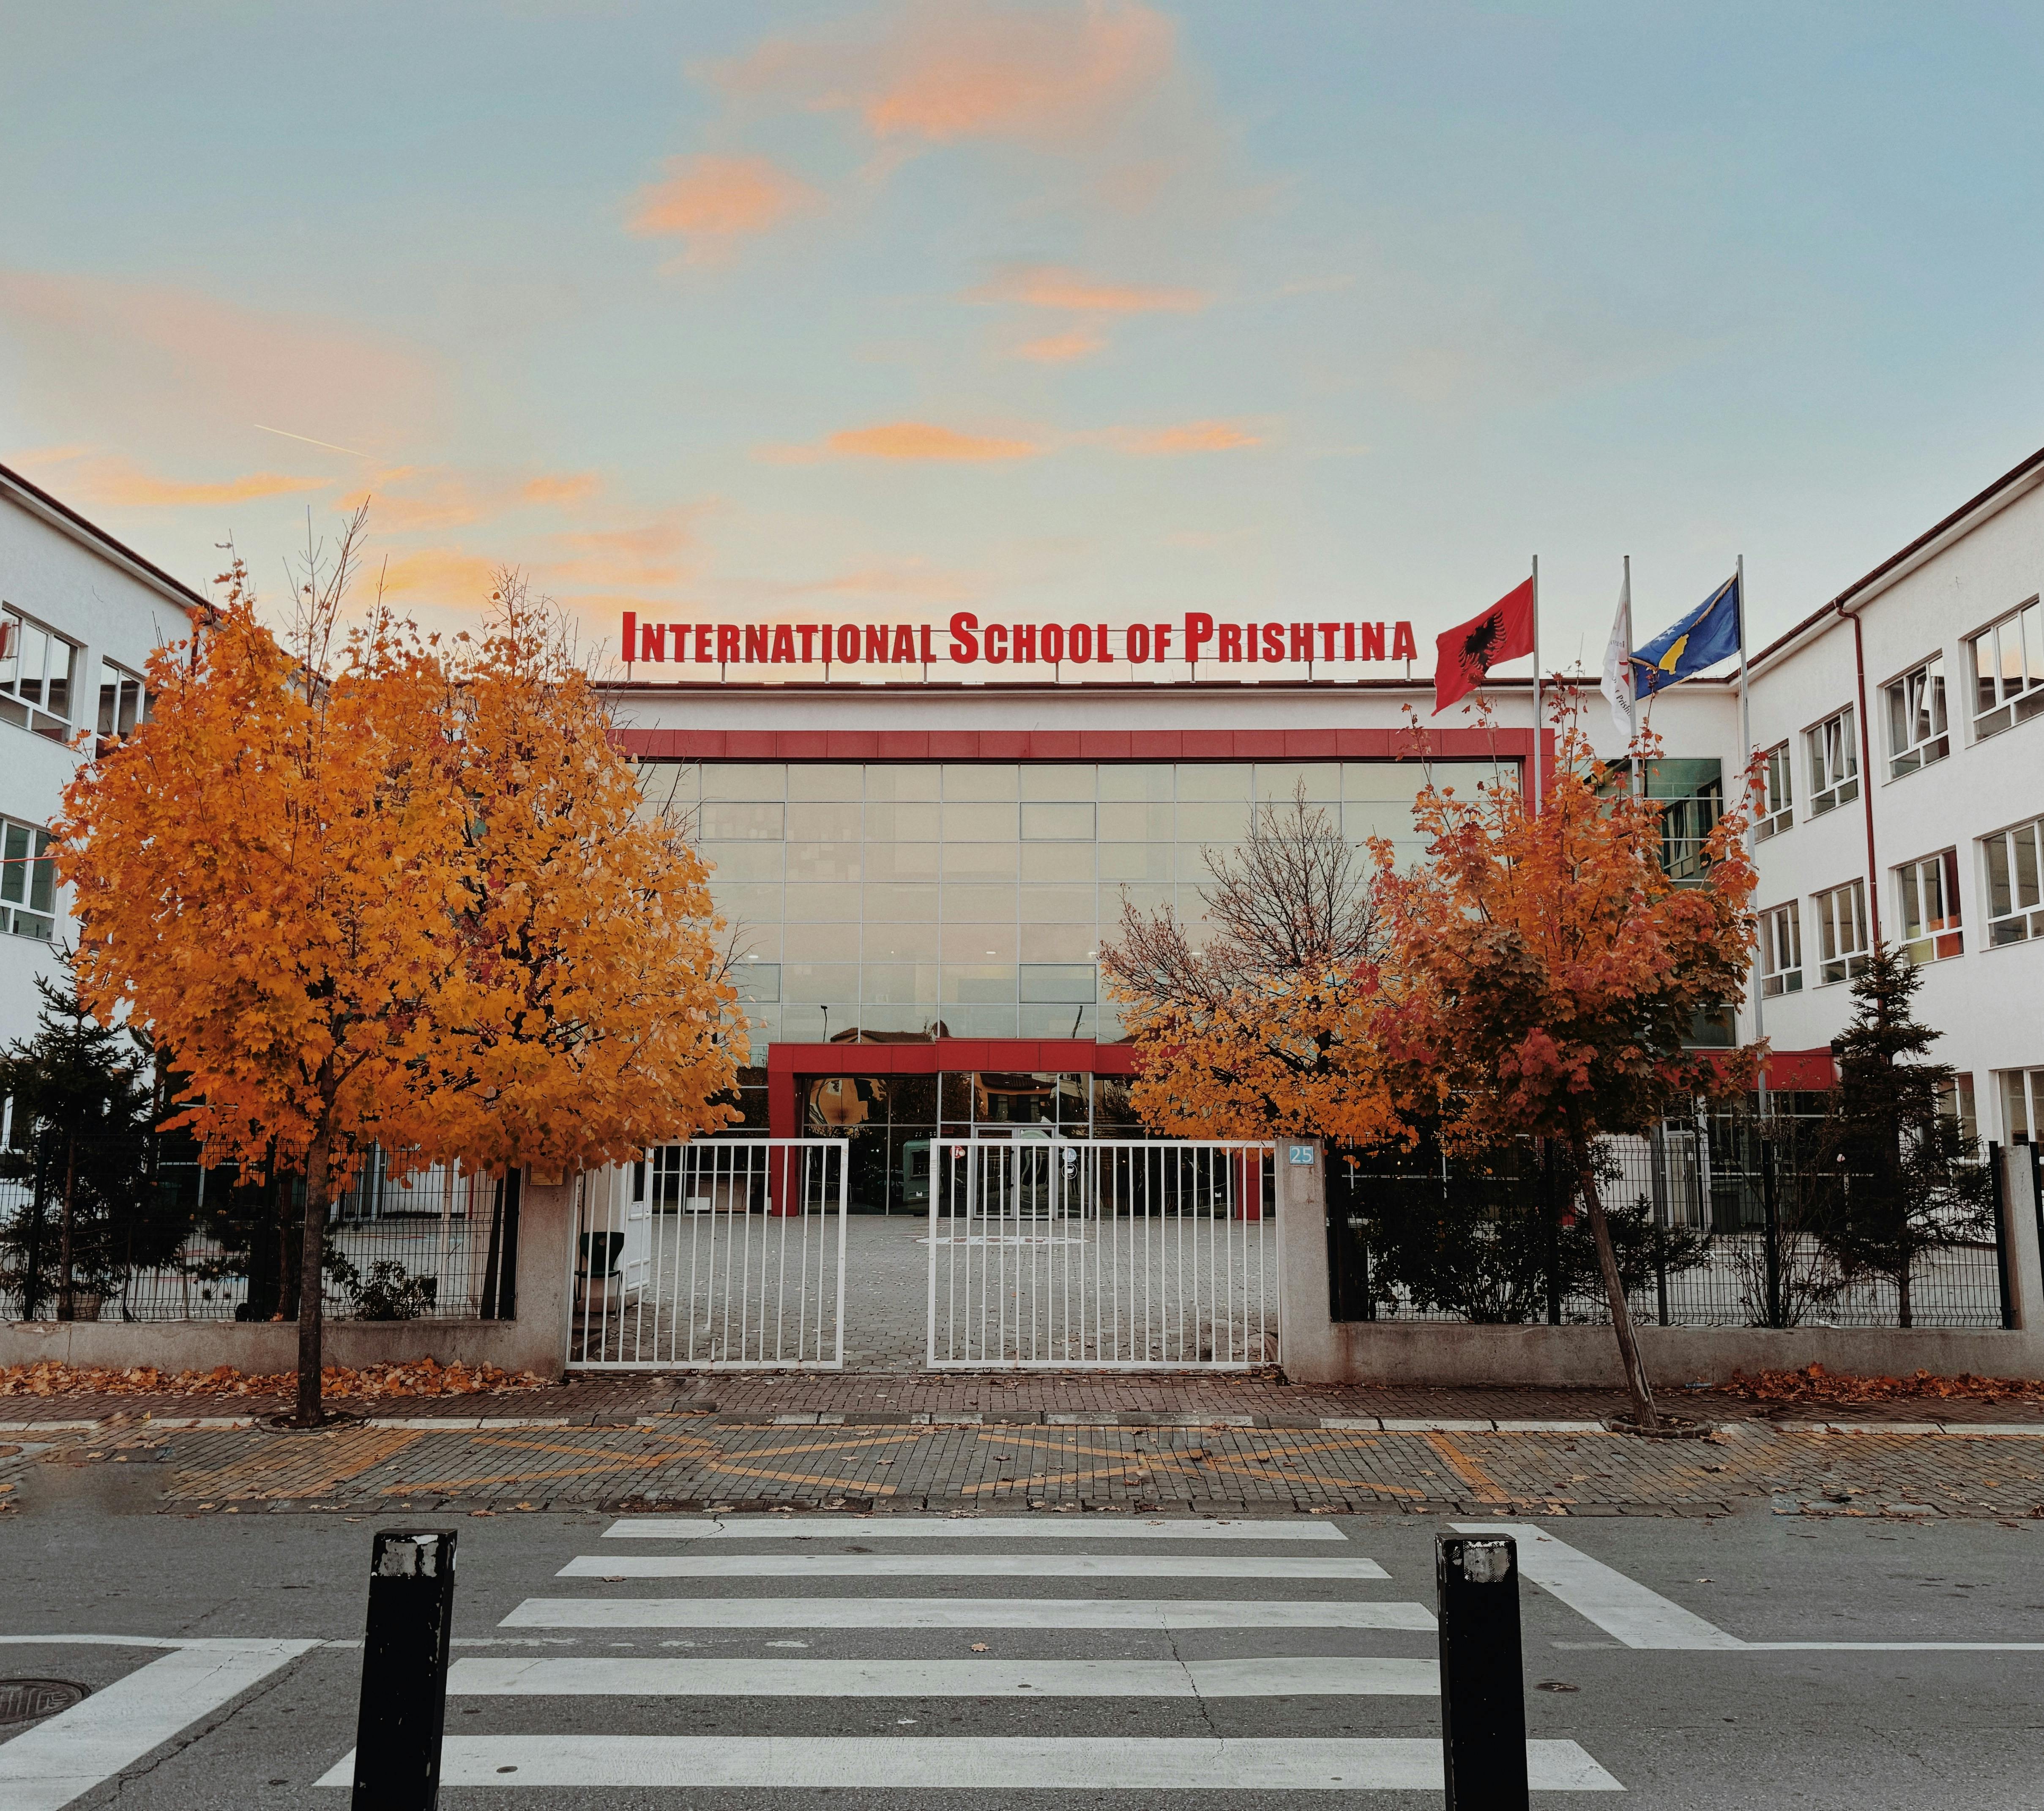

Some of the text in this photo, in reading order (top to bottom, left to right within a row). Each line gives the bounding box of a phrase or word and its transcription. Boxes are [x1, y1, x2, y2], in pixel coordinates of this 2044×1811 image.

[622, 612, 1418, 663] INTERNATIONAL SCHOOL OF PRISHTINA
[1292, 1147, 1312, 1162] 25
